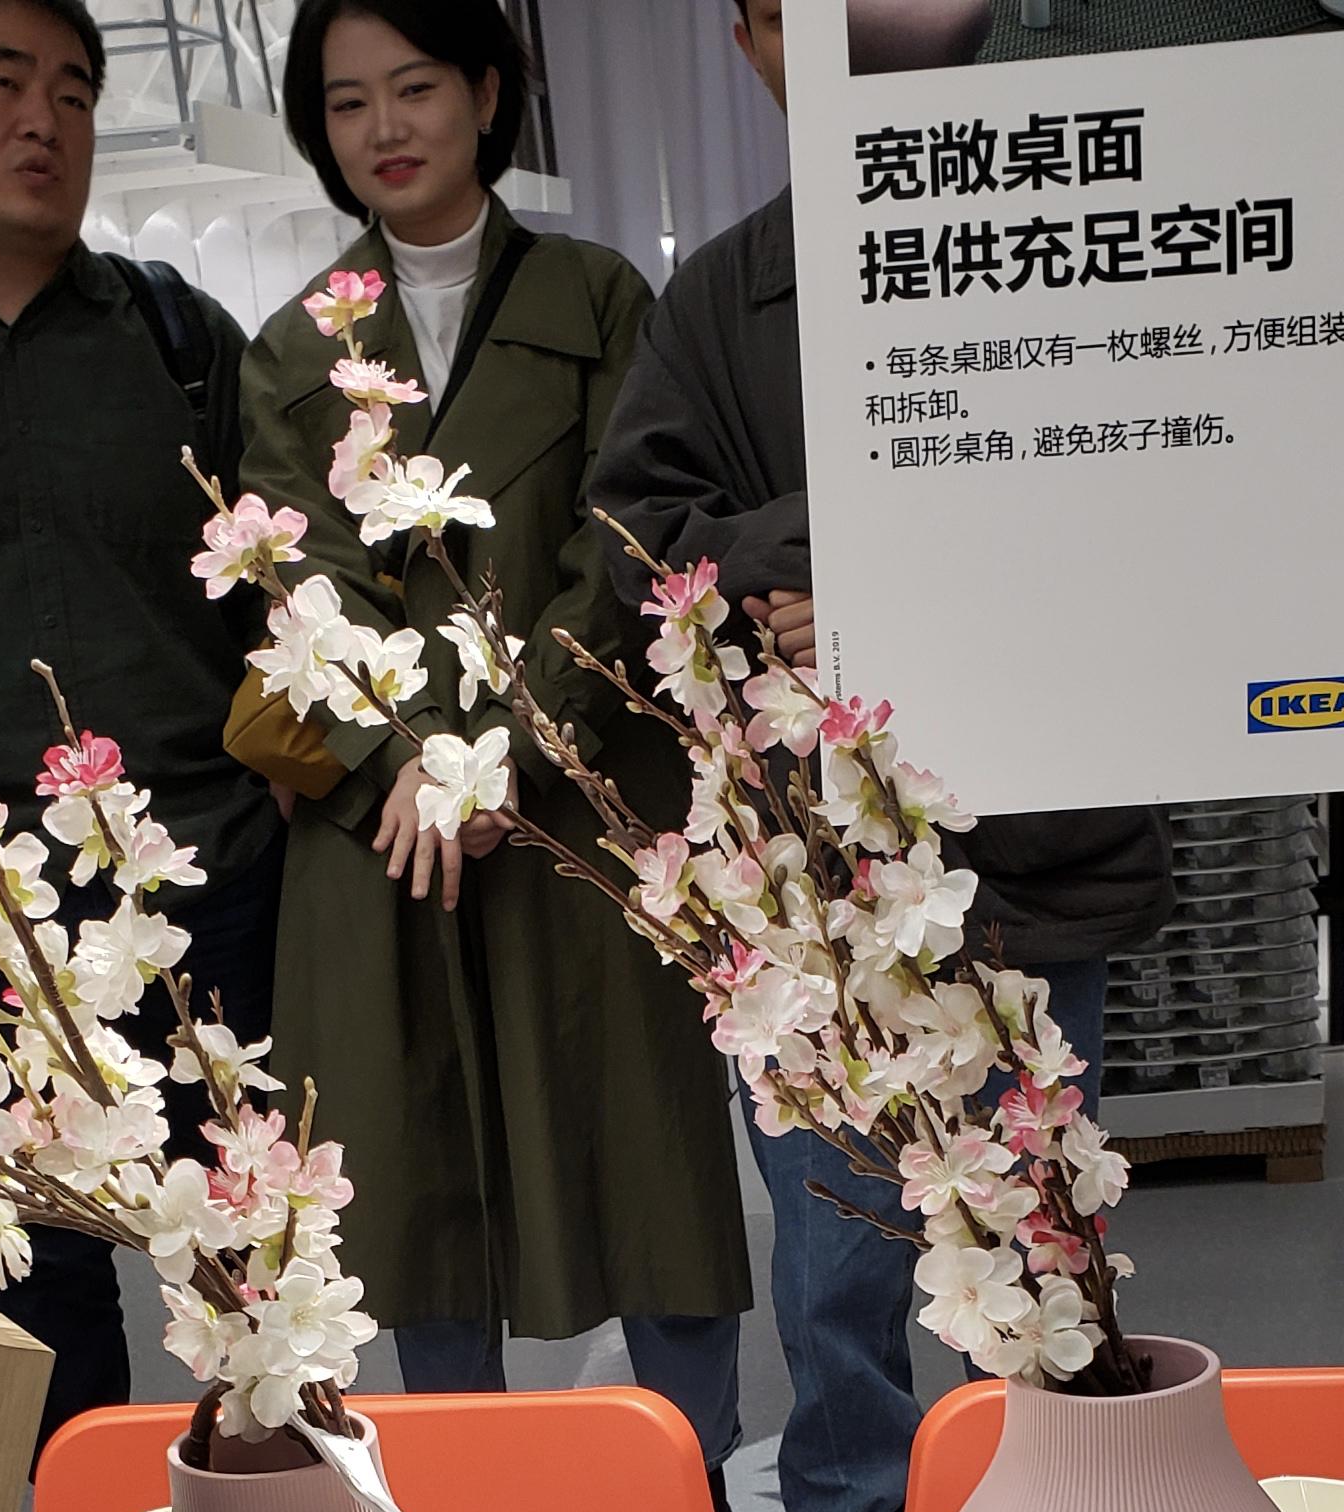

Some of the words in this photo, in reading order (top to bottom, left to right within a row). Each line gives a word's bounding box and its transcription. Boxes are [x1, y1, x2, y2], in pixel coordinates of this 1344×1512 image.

[855, 107, 1145, 204] 宽敞桌面
[858, 197, 1293, 304] 提供充足空间
[864, 388, 971, 427] 和拆卸。
[834, 673, 843, 701] ystems
